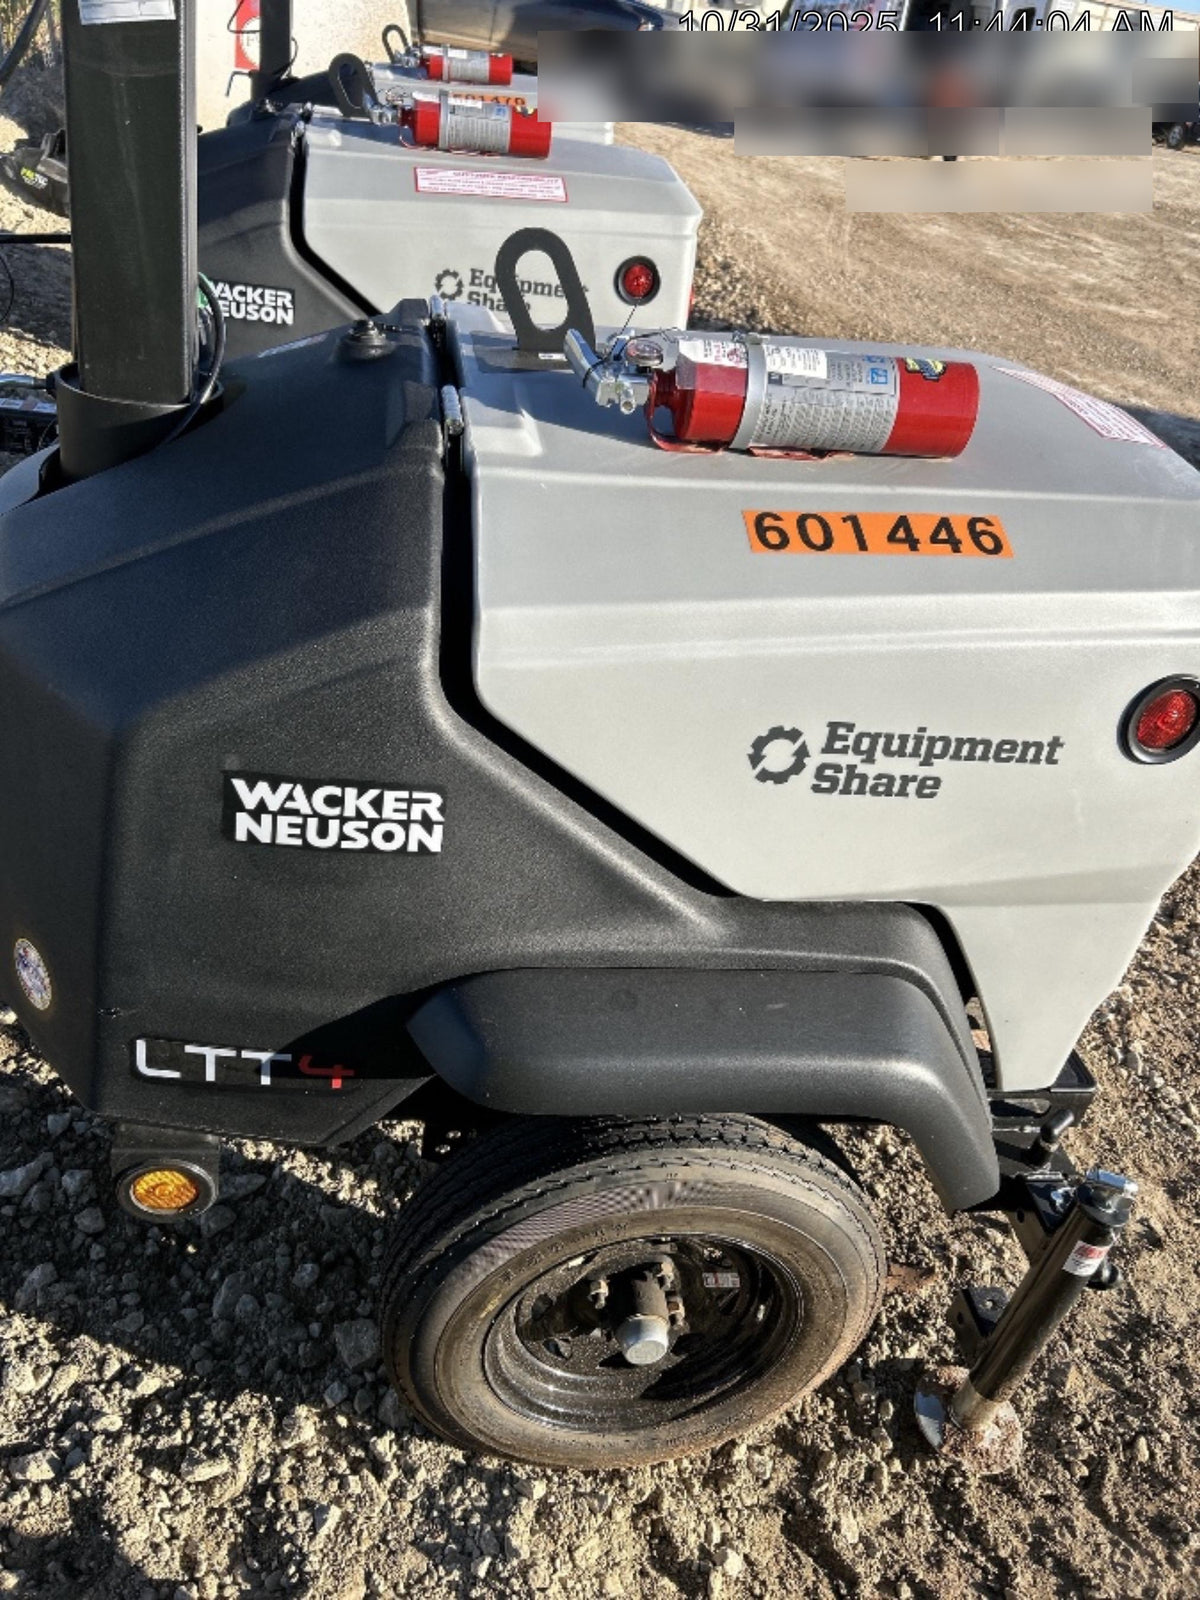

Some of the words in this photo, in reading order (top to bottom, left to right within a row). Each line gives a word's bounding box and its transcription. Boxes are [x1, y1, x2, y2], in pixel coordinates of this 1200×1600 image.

[469, 268, 589, 299] Eqpme
[213, 299, 294, 325] EUSON
[754, 511, 1004, 555] 601446
[820, 720, 1065, 767] Equipment
[230, 777, 445, 822] WACKER
[811, 762, 942, 799] Share
[235, 811, 444, 853] NEUSON
[136, 1039, 355, 1089] LTT4
